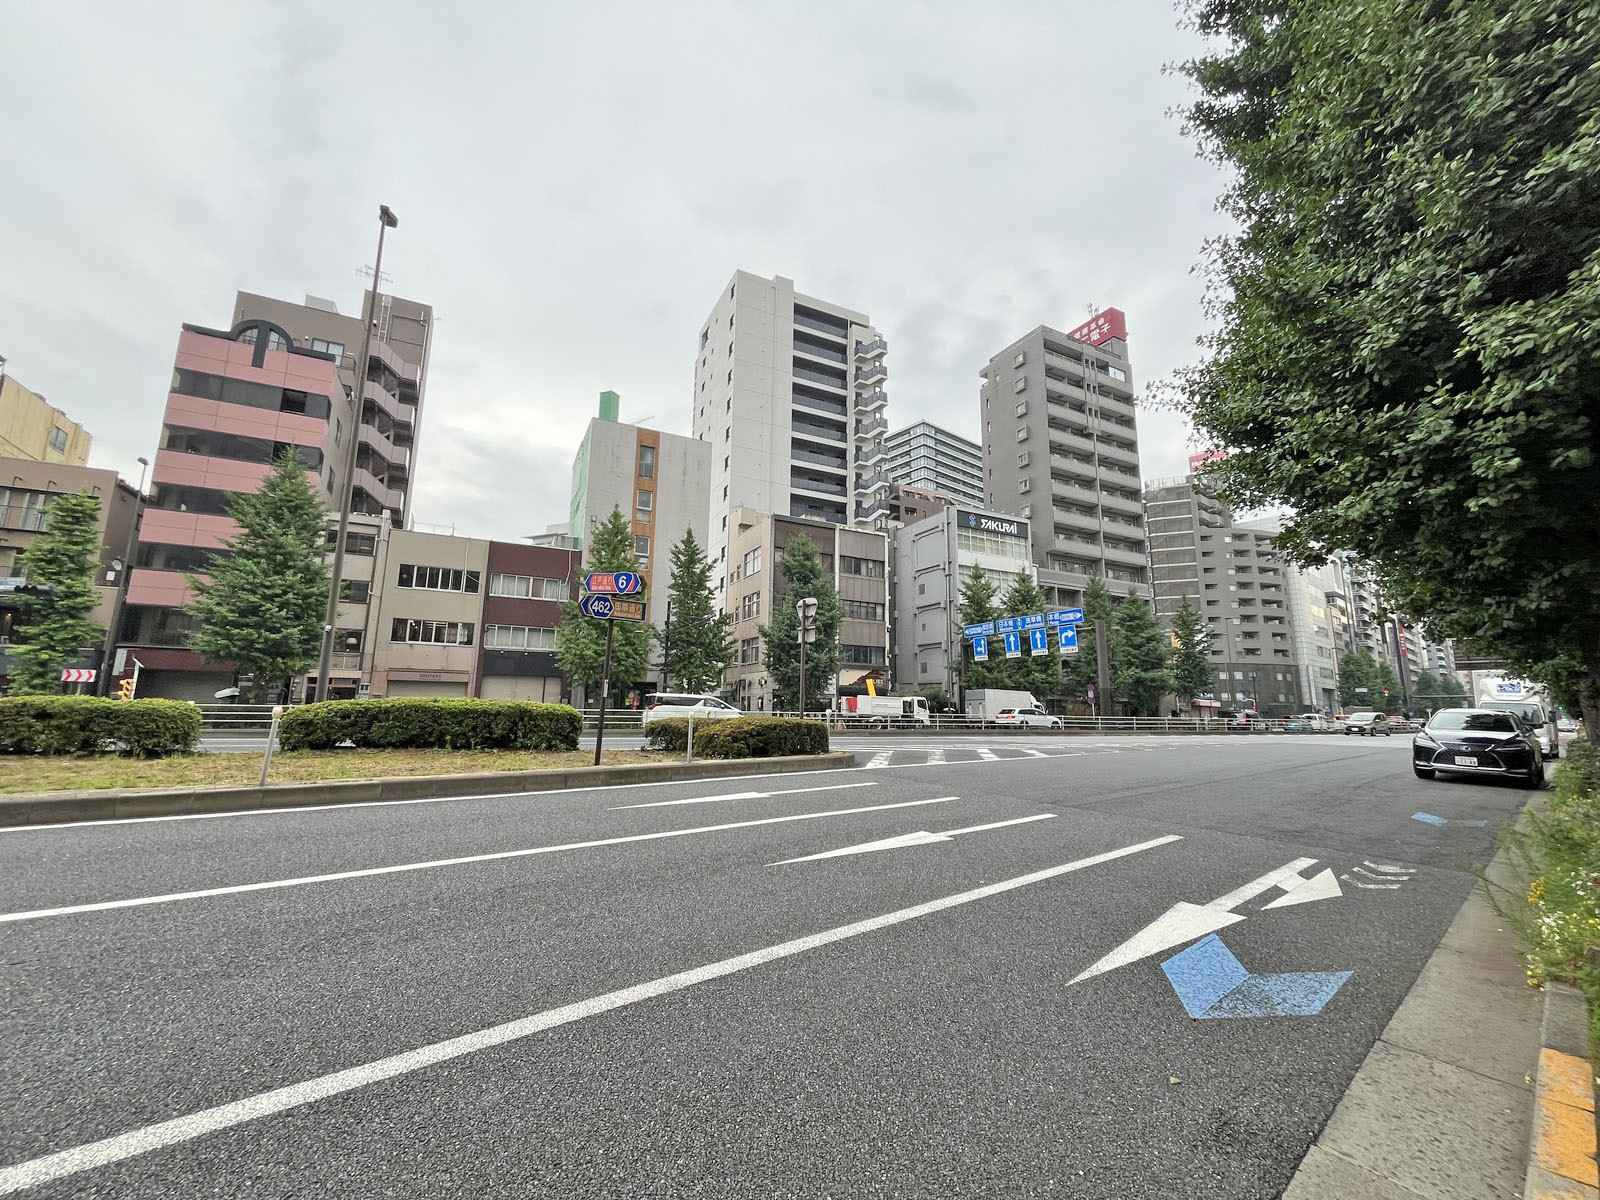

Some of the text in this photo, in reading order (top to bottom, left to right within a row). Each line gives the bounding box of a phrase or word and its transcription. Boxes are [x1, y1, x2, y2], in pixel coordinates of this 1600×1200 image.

[981, 519, 1017, 534] SAKURAI
[618, 576, 626, 588] 6
[592, 601, 610, 613] 462
